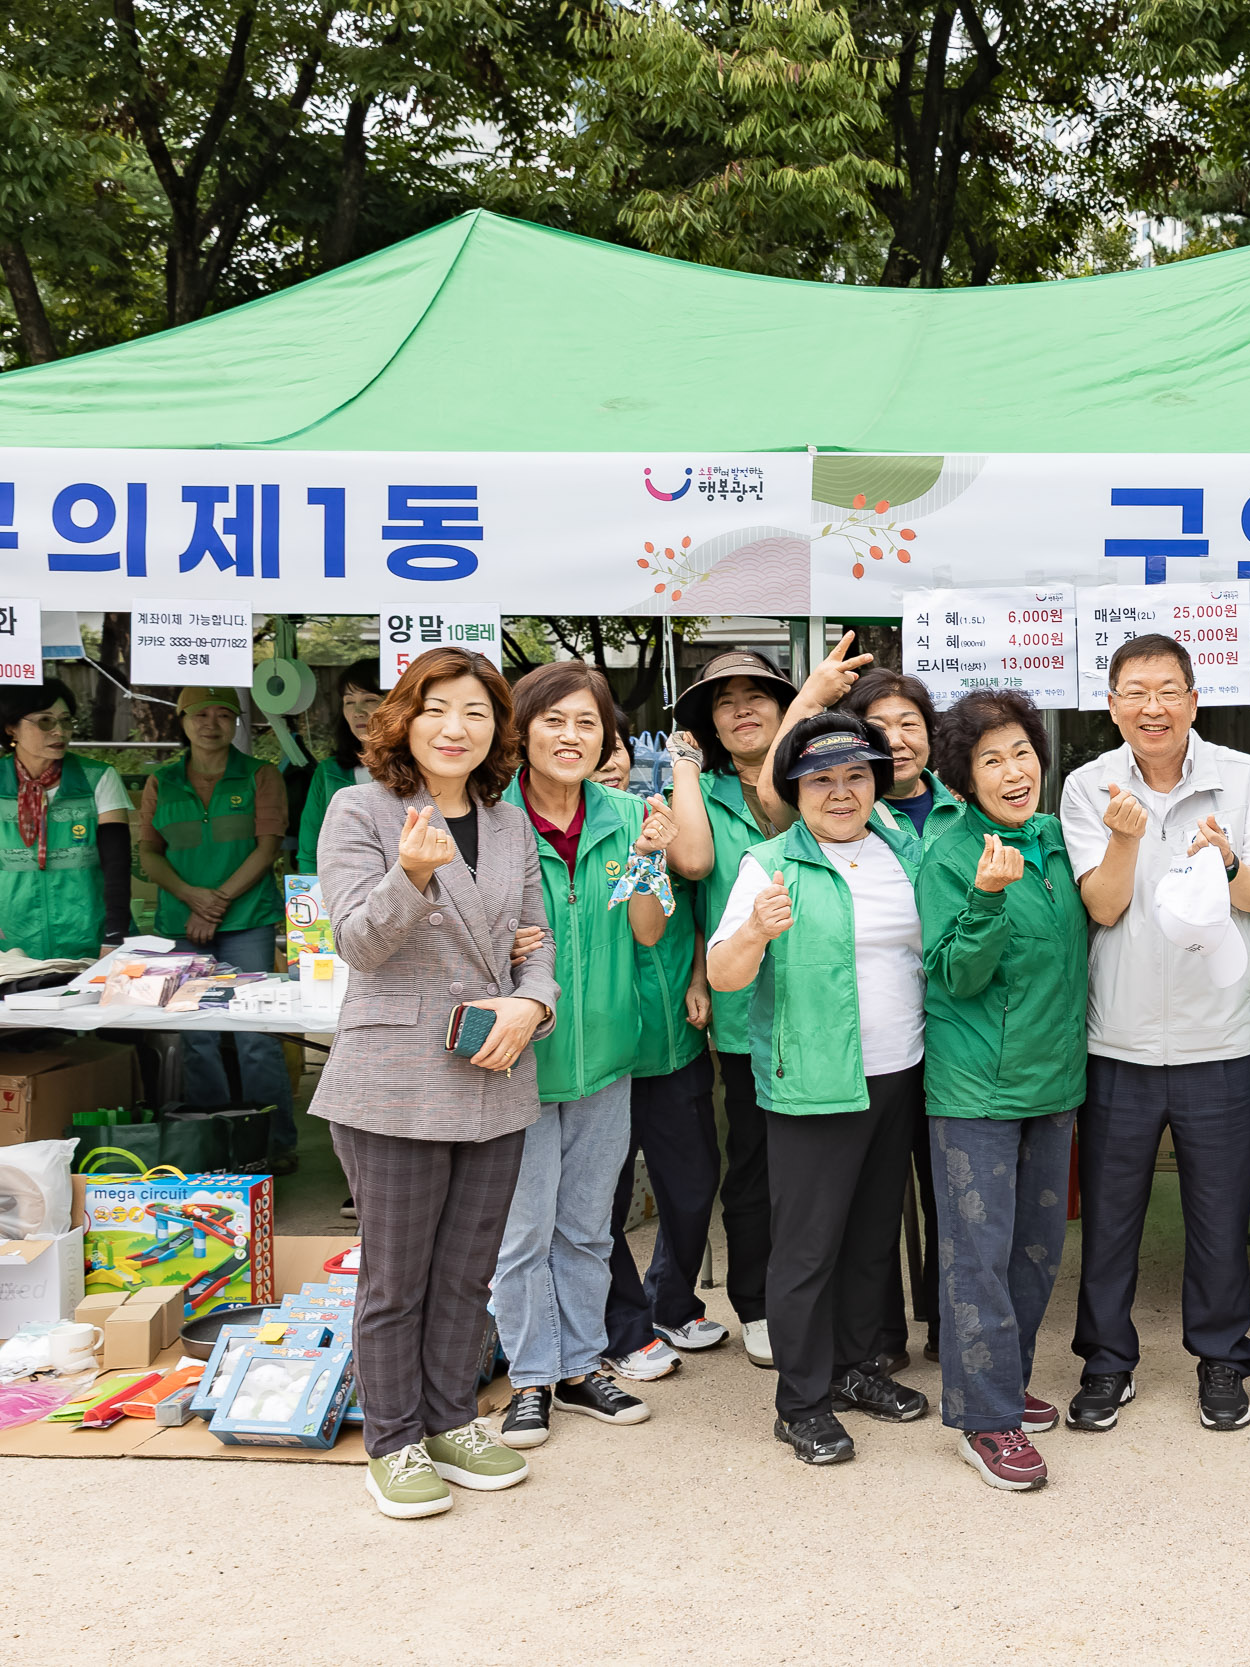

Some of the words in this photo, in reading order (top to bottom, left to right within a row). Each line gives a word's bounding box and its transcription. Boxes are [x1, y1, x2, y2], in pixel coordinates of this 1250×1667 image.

[698, 479, 763, 502] 행복광진
[0, 481, 484, 582] 의제1동
[137, 612, 182, 625] 계좌이체
[189, 613, 248, 627] 가능합니다.
[1008, 608, 1063, 624] 6,000원
[1094, 607, 1156, 623] 매실액(2L)
[1173, 603, 1237, 620] 25,000원
[137, 636, 165, 647] 카카오
[169, 636, 248, 649] 3333-09-0771822
[1008, 632, 1064, 647] 4,000원
[1174, 627, 1238, 643] 25,000원
[1001, 655, 1064, 671] 13,000원
[960, 678, 999, 688] 계좌이체
[1004, 677, 1023, 687] 가능
[94, 1189, 135, 1202] mega
[140, 1188, 188, 1200] circuit
